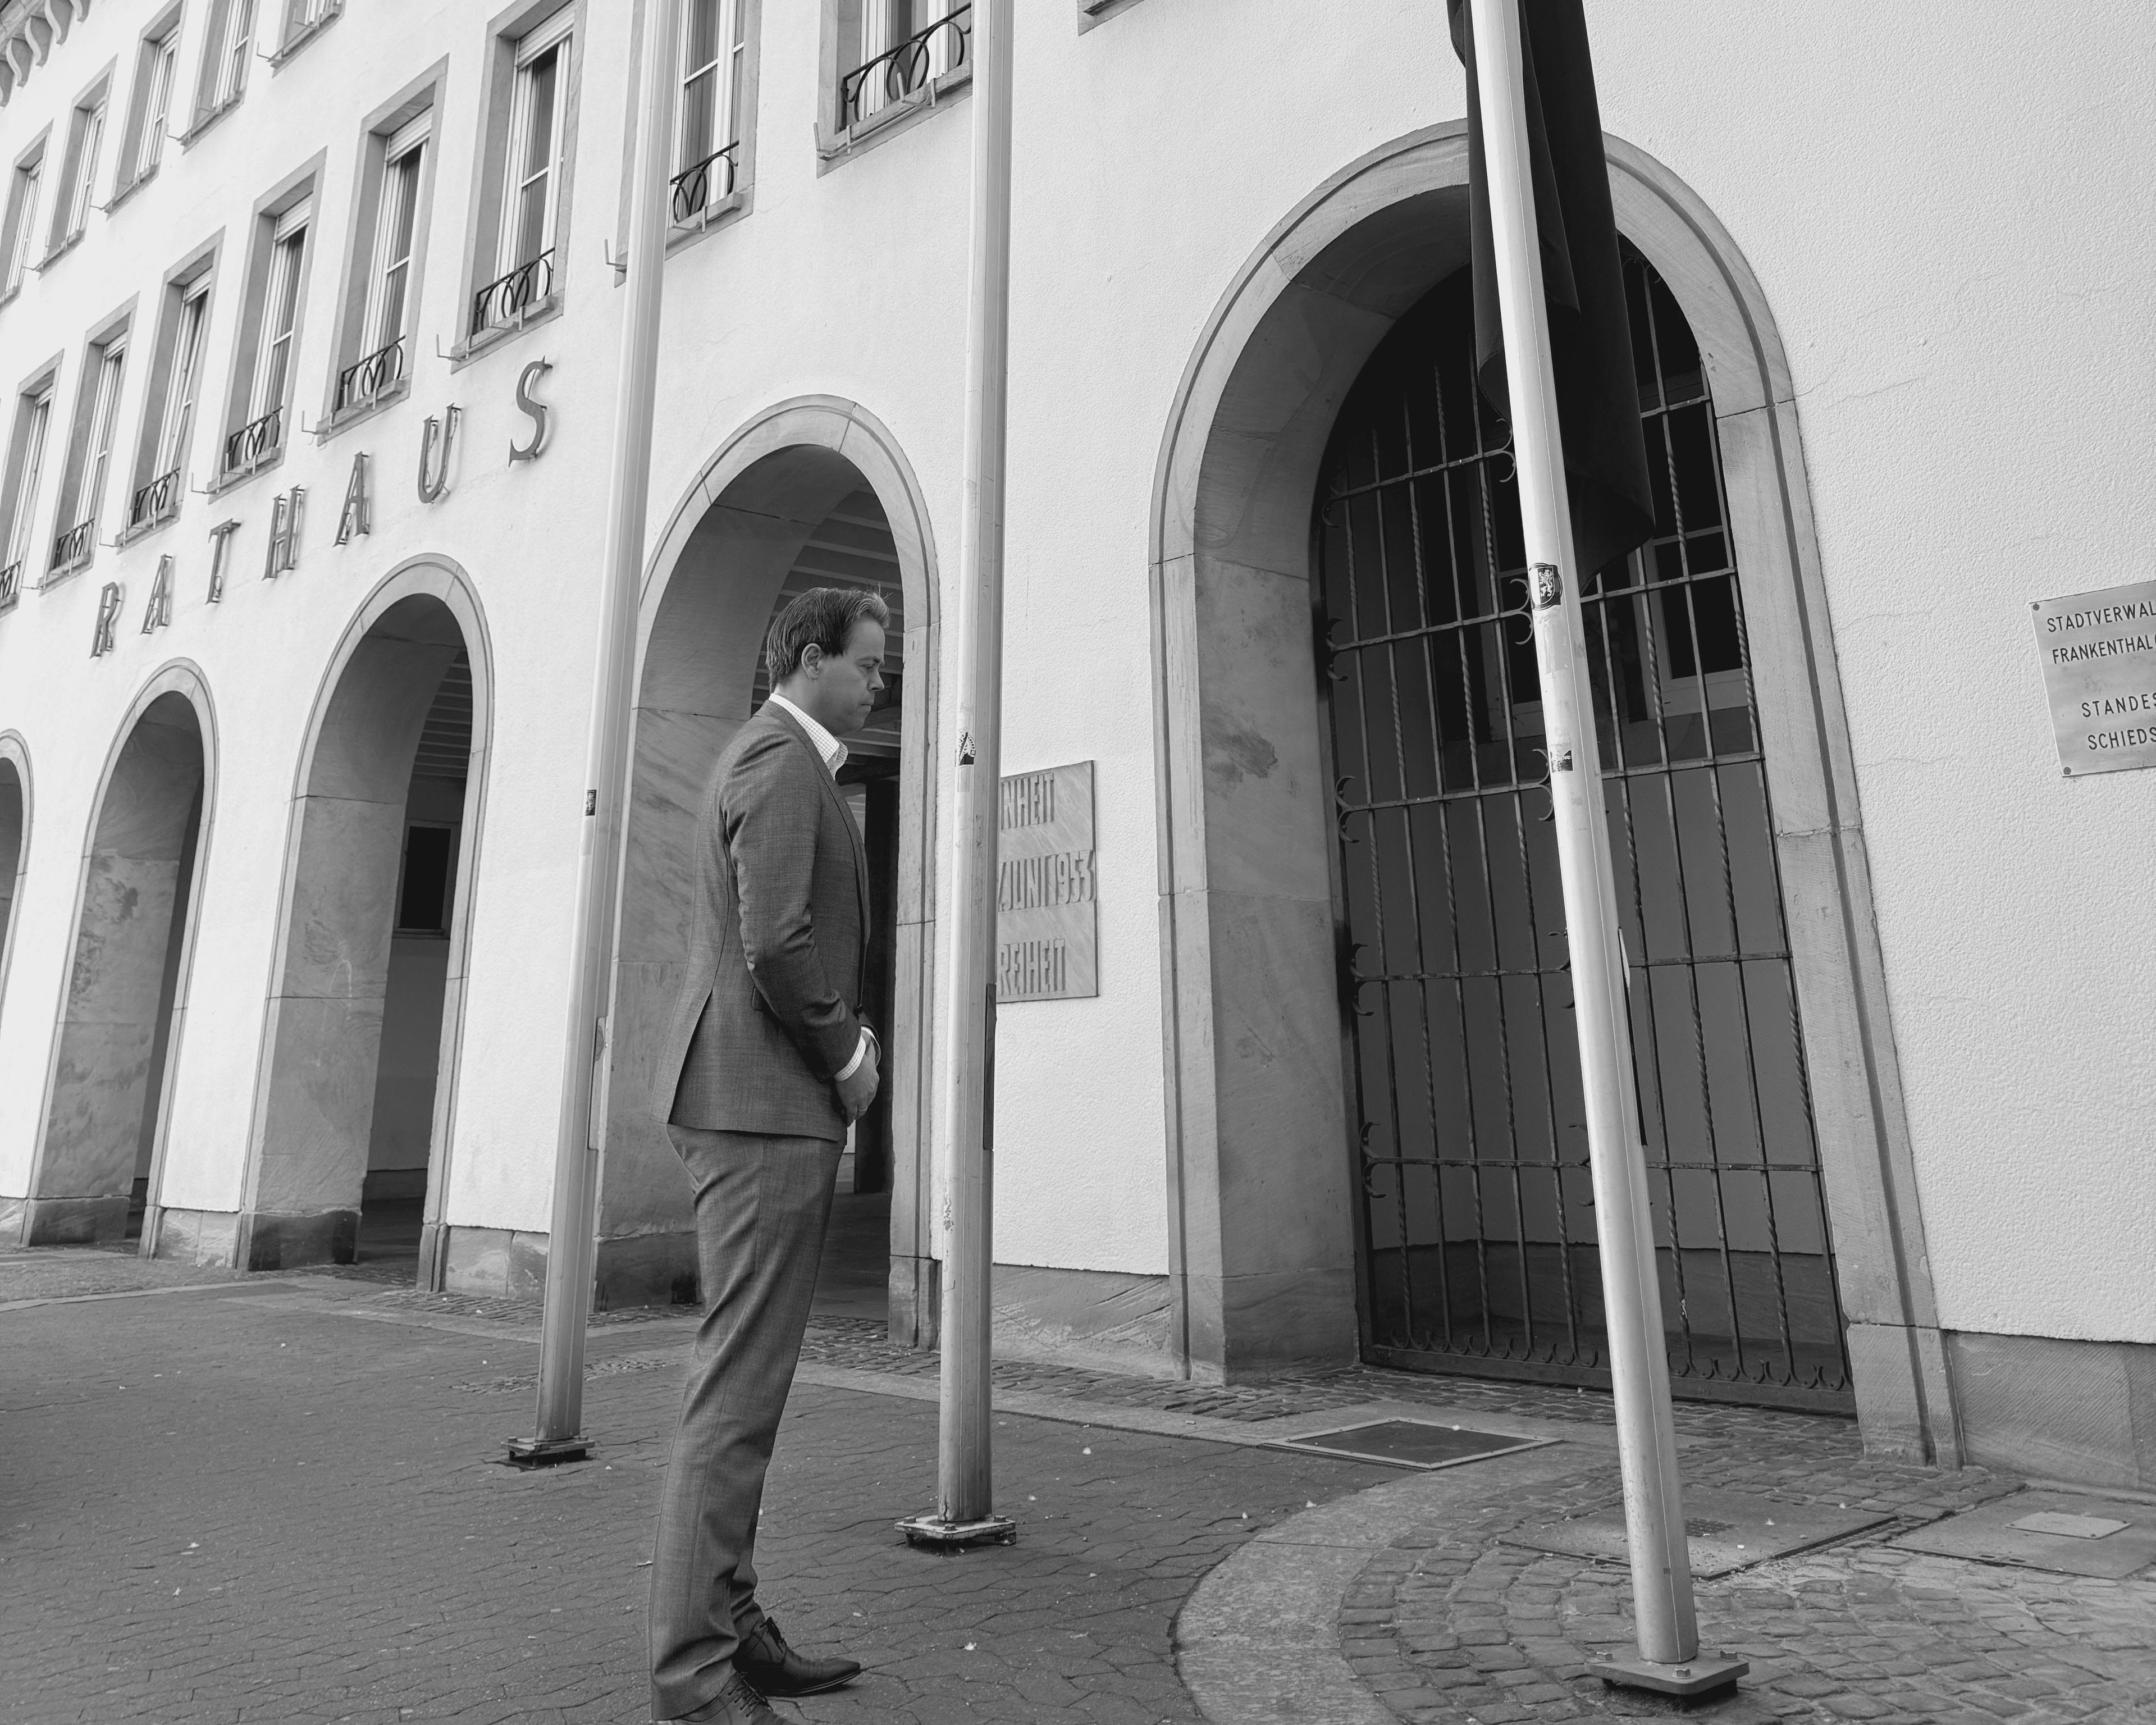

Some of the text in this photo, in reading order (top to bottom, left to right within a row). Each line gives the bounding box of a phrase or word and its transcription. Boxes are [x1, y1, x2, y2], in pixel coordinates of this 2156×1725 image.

[90, 355, 553, 658] RATHAUS
[2052, 635, 2154, 664] FRANKENTHAL
[2088, 727, 2156, 750] SCHIEDS
[1001, 772, 1055, 830] NHEIT
[997, 938, 1066, 996] REIHEIT
